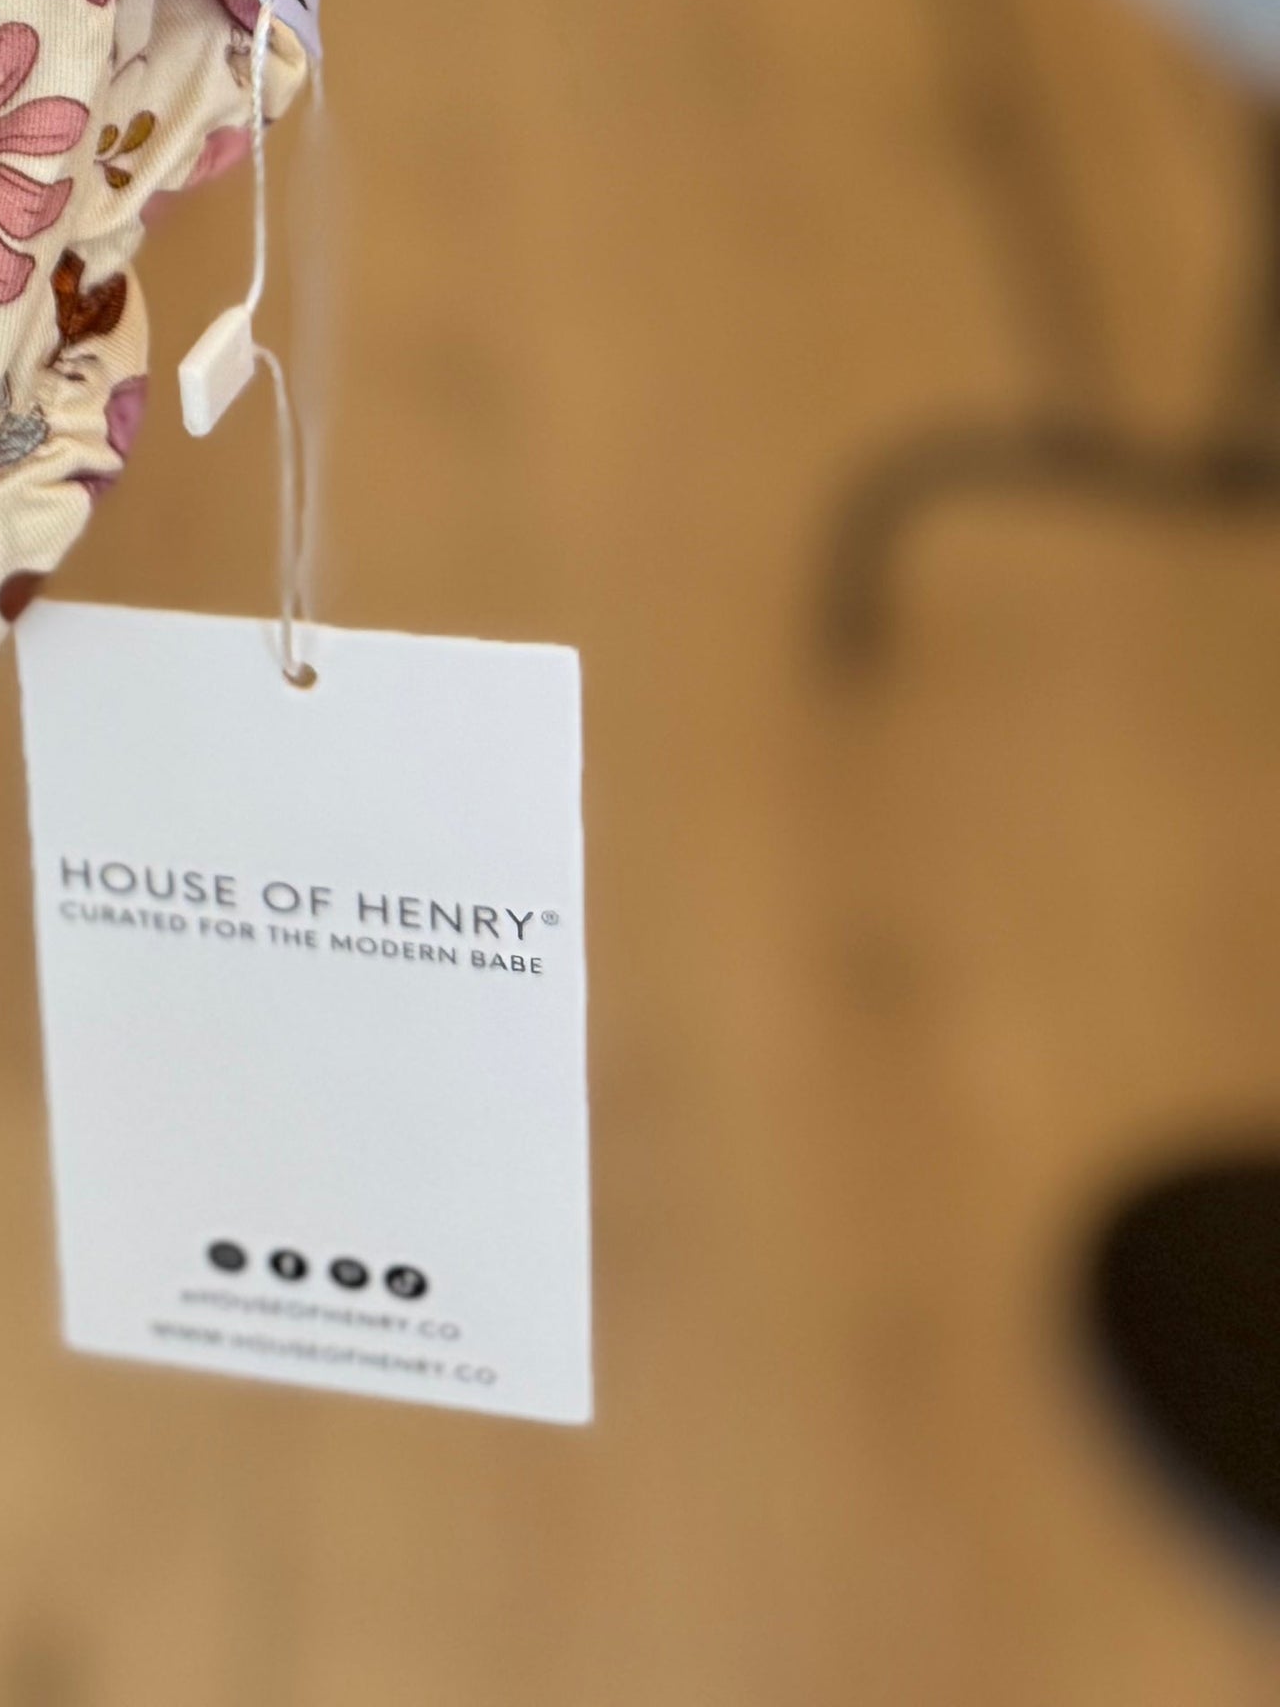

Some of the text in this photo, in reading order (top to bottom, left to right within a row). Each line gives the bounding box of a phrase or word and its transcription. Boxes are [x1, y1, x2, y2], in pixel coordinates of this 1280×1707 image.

[60, 856, 237, 909] HOUSE
[262, 881, 333, 917] OF
[59, 900, 543, 975] CURATED FOR THE MODERN BABE
